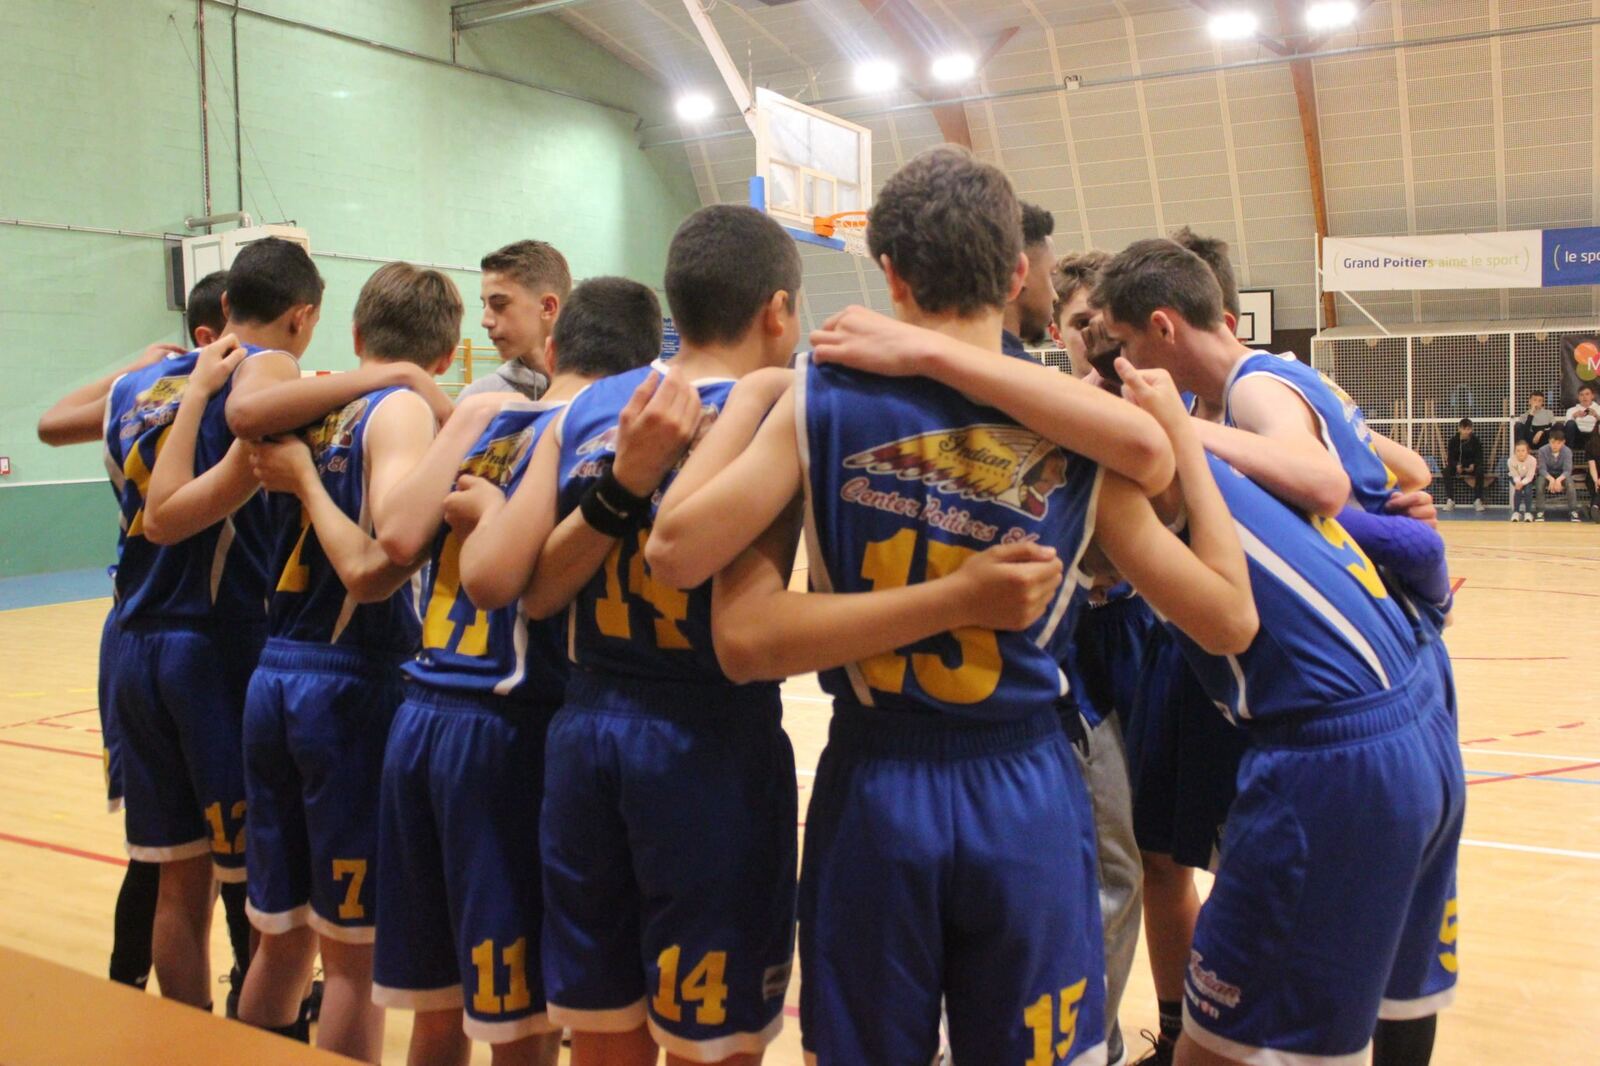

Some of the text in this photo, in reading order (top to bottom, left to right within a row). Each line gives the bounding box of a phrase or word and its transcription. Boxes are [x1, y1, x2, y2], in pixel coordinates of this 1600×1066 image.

[1343, 253, 1519, 270] Grand Poitiers aime le sport
[1565, 250, 1577, 263] le
[939, 432, 1012, 471] Indian
[840, 476, 921, 519] Center
[919, 494, 998, 542] Poitiers
[332, 859, 367, 919] 7
[471, 937, 530, 1014] 11
[652, 944, 728, 1025] 14
[1023, 976, 1088, 1066] 15
